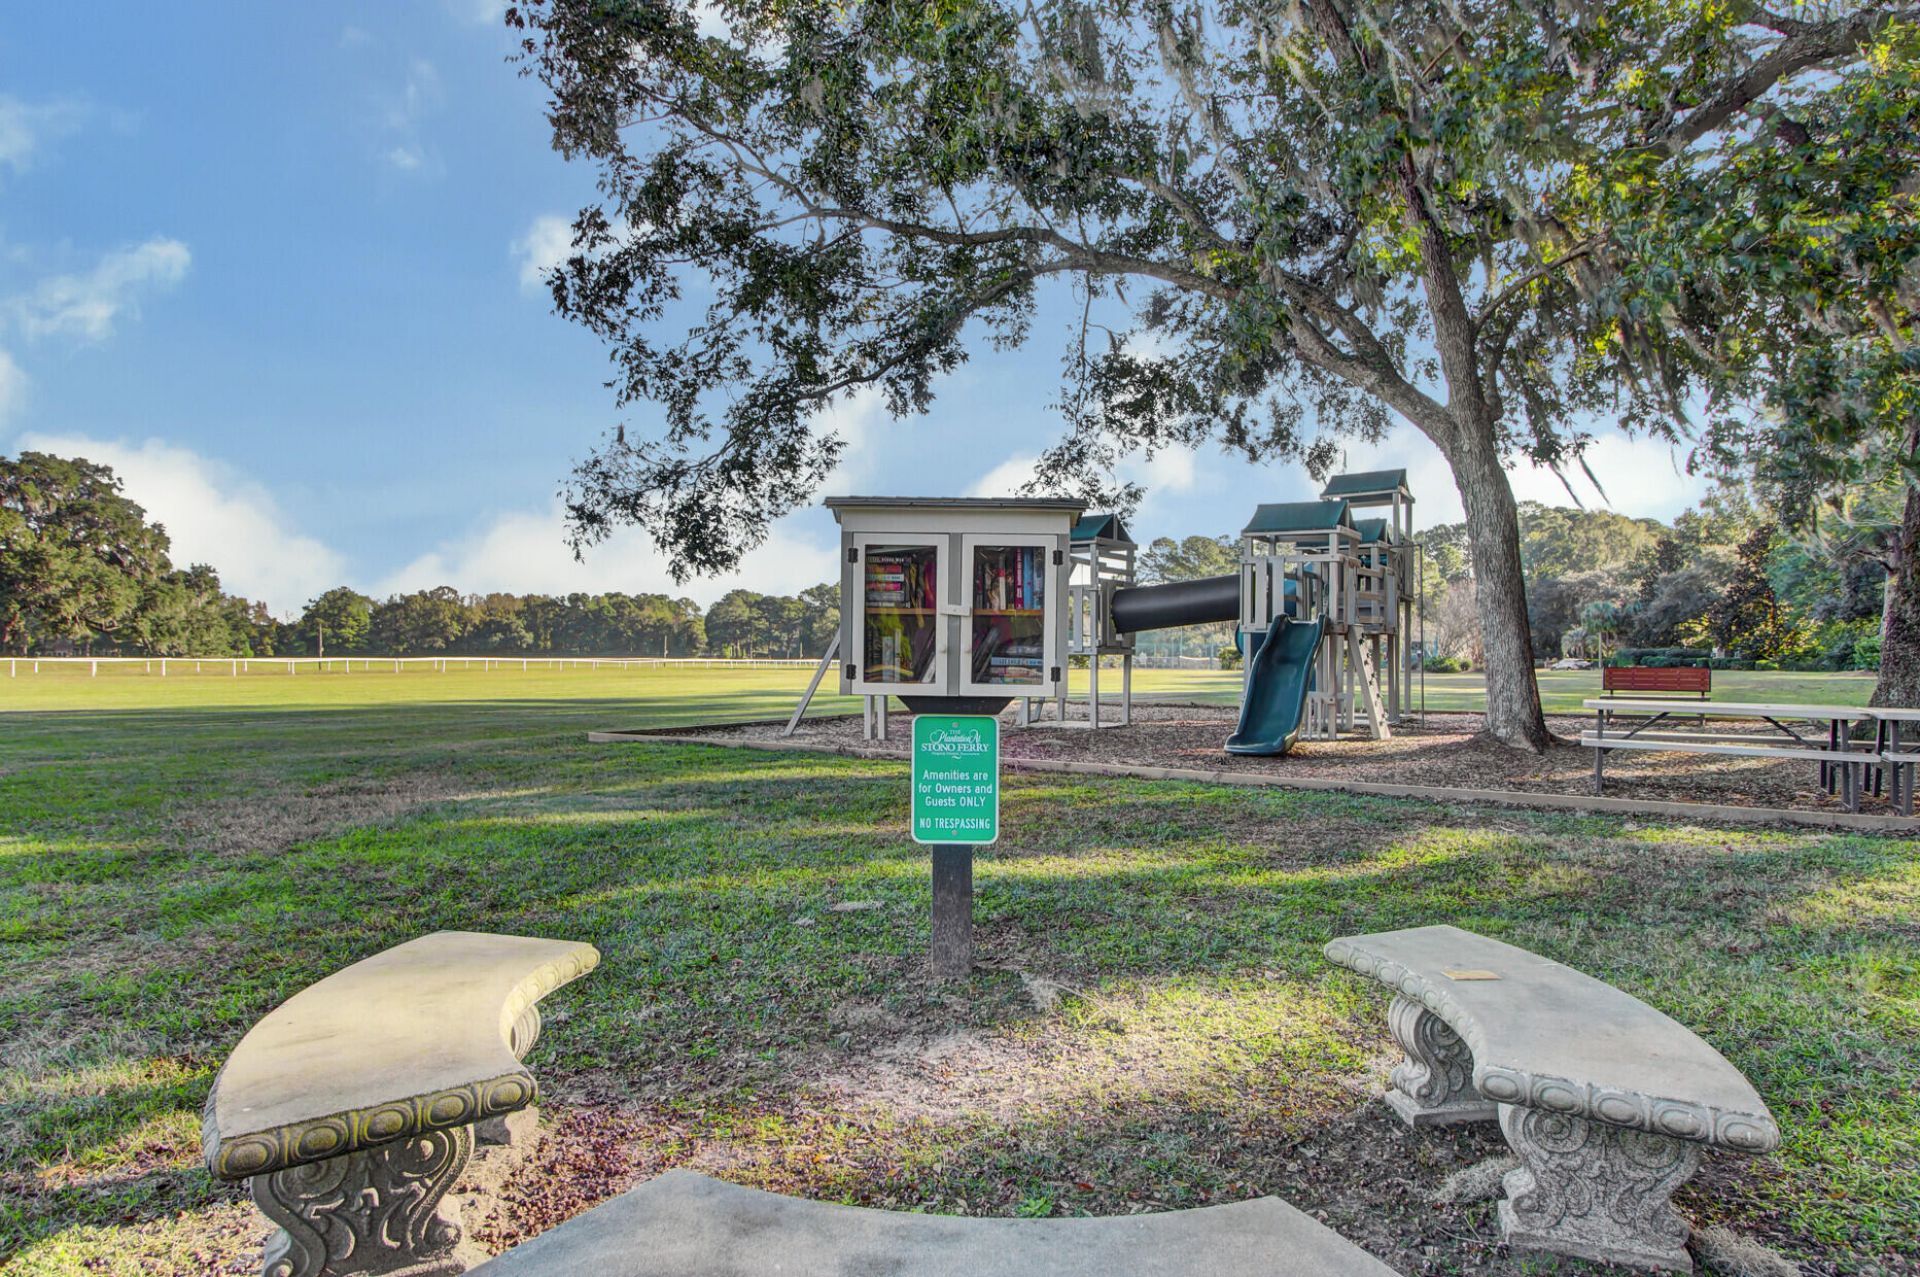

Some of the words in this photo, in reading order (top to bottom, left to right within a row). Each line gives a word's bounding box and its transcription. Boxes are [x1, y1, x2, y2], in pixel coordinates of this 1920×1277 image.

[921, 743, 955, 752] STONO
[957, 743, 989, 752] FERRY
[923, 769, 970, 780] Amenities
[973, 772, 988, 780] are
[918, 783, 931, 794] for
[935, 783, 971, 794] Owners
[975, 784, 993, 794] and
[925, 796, 956, 807] Guests
[959, 796, 986, 807] ONLY
[919, 817, 931, 829] NO
[935, 817, 991, 829] TRESPASSING
